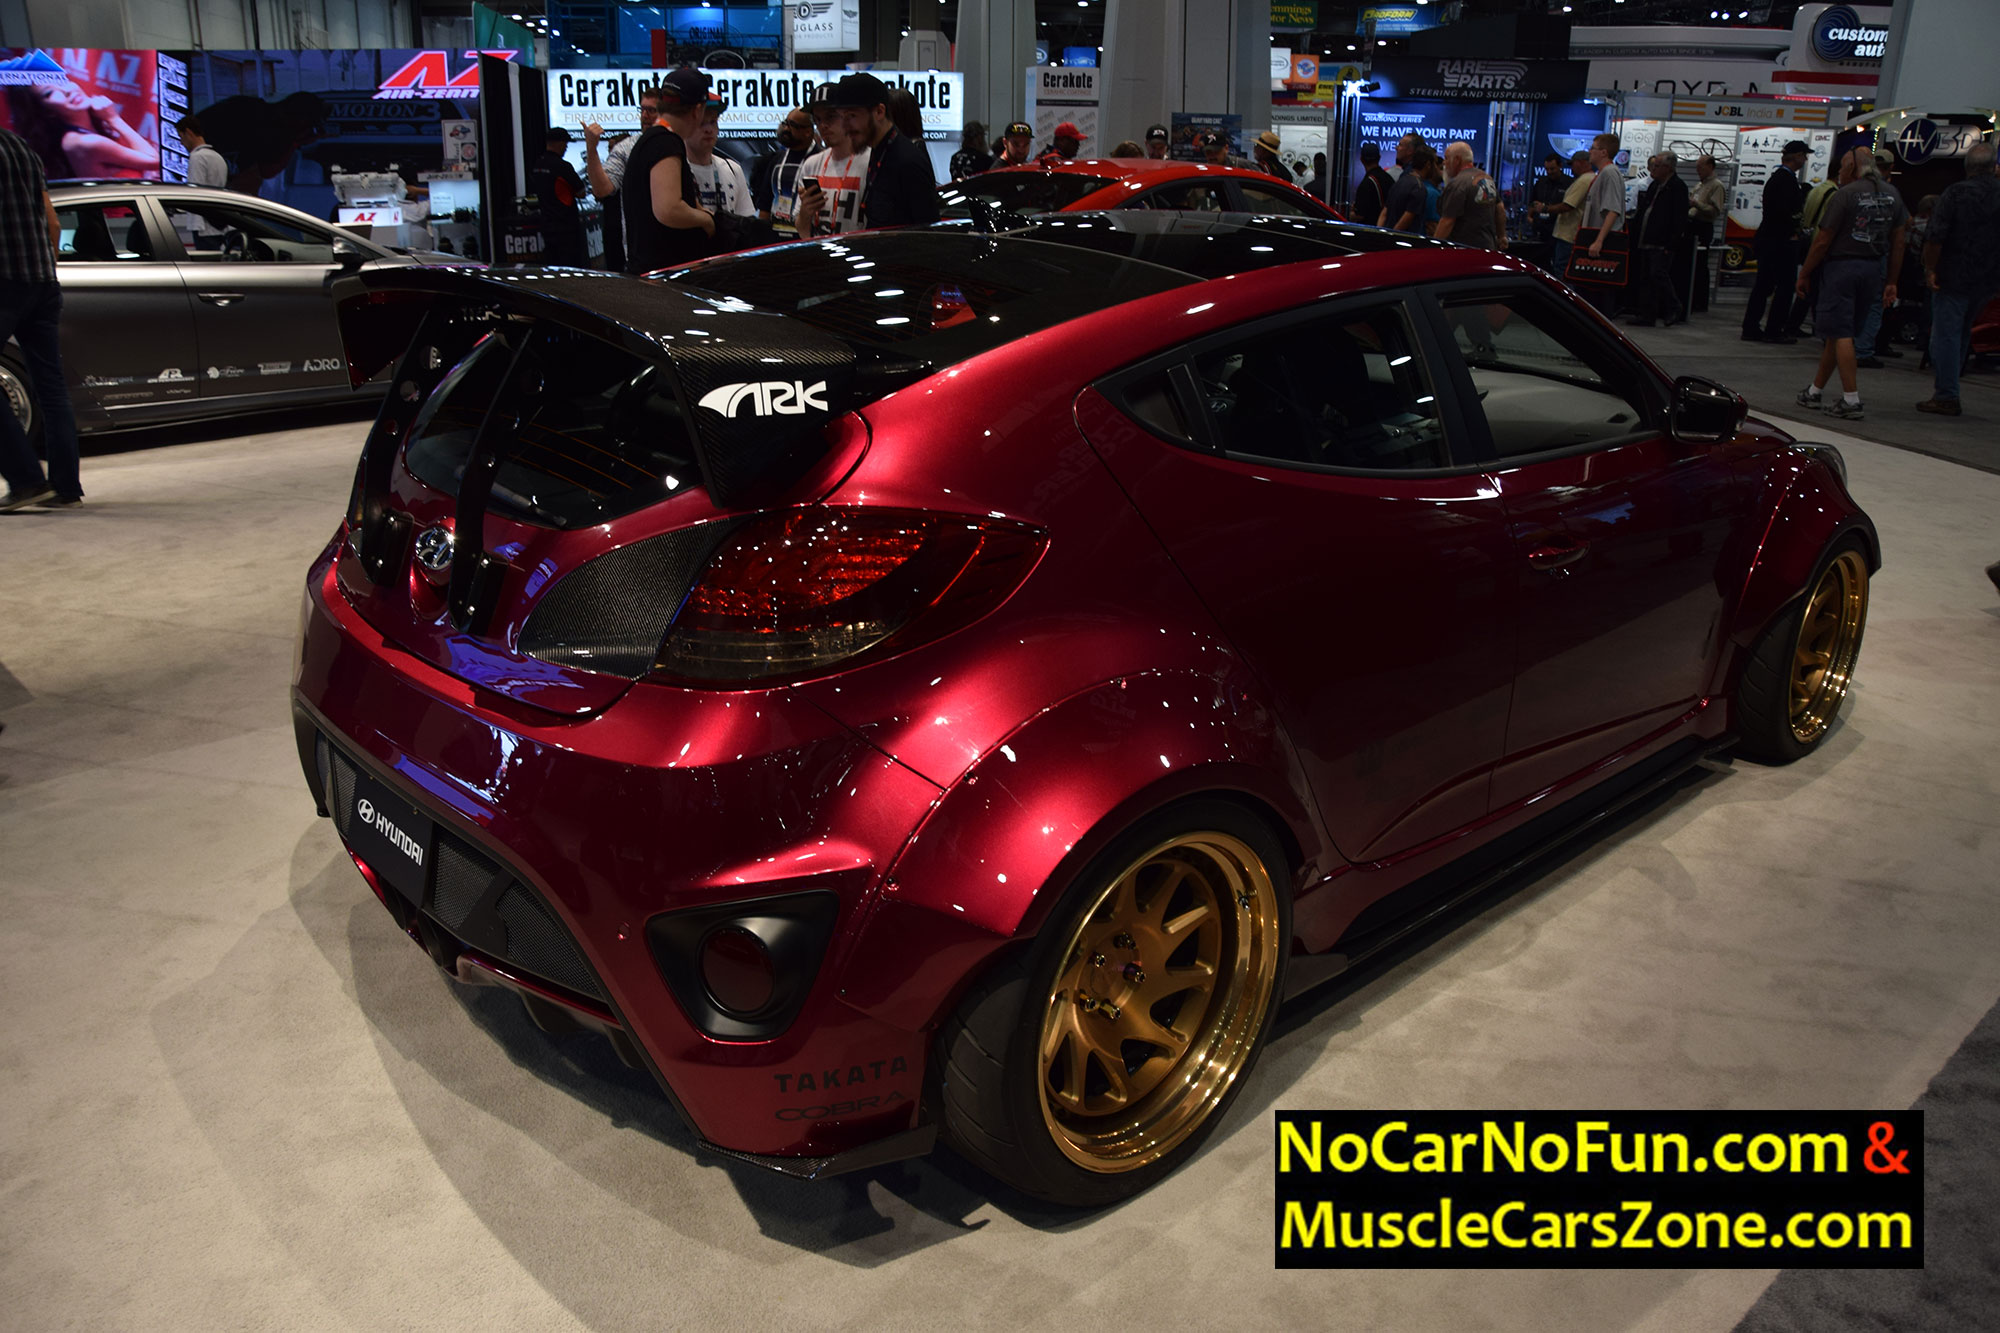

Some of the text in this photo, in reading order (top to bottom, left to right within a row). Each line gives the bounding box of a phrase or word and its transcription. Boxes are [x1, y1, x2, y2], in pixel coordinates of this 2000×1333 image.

[1289, 13, 1315, 24] News
[1828, 27, 1888, 43] custom
[1437, 60, 1488, 73] RARE
[1043, 72, 1094, 89] Cerakote
[1457, 74, 1518, 90] PARTS
[1409, 88, 1548, 100] STEERING AND SUSPENSION
[330, 103, 415, 118] MOTION
[1714, 105, 1773, 118] JCBL India
[564, 113, 615, 123] FIREARM
[1364, 115, 1423, 124] DIAMOND SERIES
[730, 131, 757, 139] LEADING
[930, 132, 947, 140] COAT
[1361, 126, 1379, 137] WE
[1416, 128, 1447, 139] YOUR
[1449, 129, 1478, 140] PART
[354, 212, 376, 222] AZ
[303, 358, 342, 372] ADRO
[698, 380, 830, 418] ARK
[375, 811, 424, 867] HYUNDAI
[774, 1056, 908, 1093] TAKATA
[775, 1090, 906, 1121] COBRA
